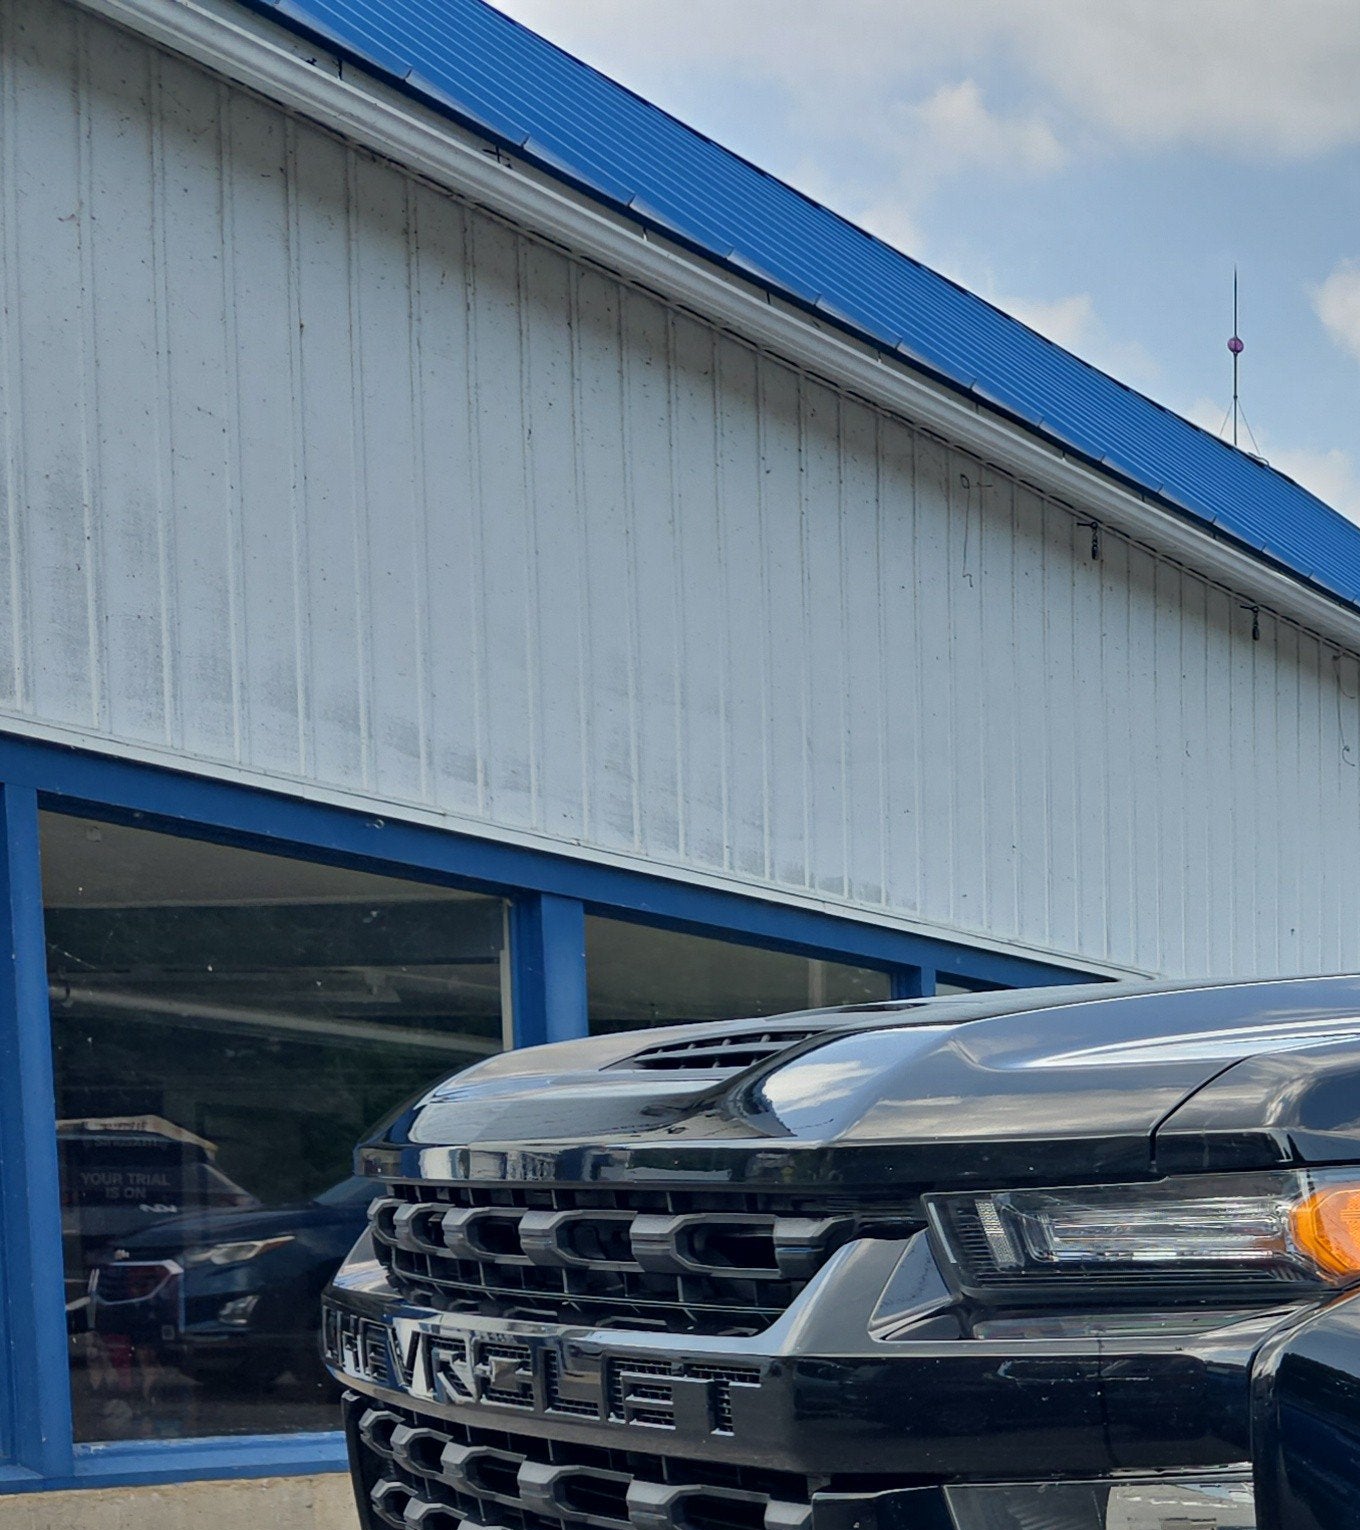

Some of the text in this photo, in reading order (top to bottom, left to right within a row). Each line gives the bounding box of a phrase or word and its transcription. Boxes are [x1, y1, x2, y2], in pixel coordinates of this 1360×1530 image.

[80, 1172, 171, 1187] YOUR TRIAL
[105, 1186, 147, 1200] IS ON
